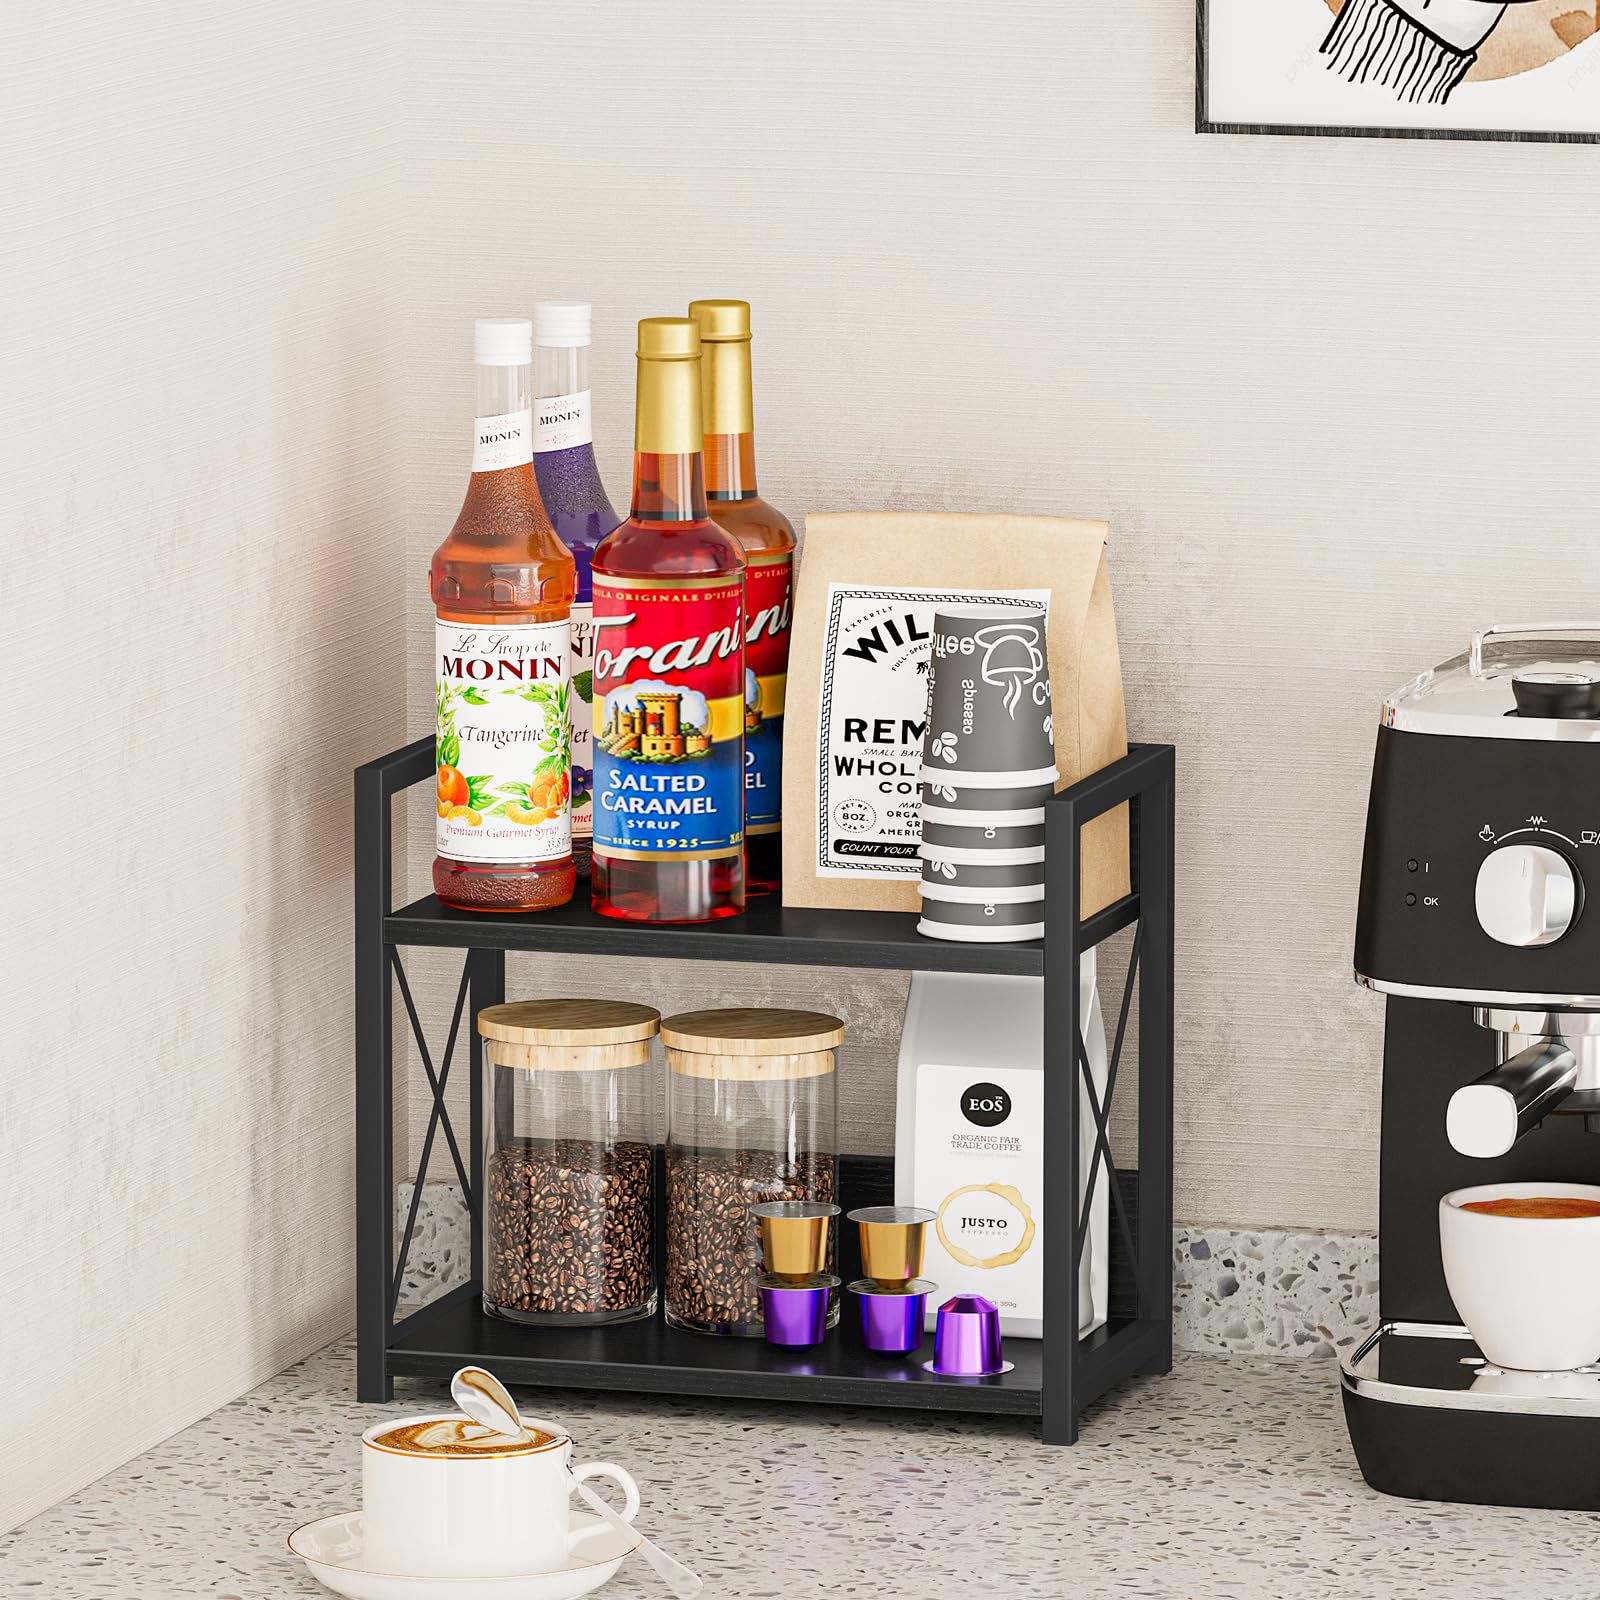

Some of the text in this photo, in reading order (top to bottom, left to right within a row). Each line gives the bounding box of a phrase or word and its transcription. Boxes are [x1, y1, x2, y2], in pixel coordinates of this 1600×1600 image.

[540, 409, 580, 426] MONIN
[480, 428, 521, 445] MONIN
[616, 591, 699, 602] ORIGINALE
[844, 606, 893, 633] EXPERTLY
[452, 633, 552, 659] Le Sirop de
[442, 655, 561, 680] MONIN
[458, 724, 544, 750] Tangerine
[862, 748, 895, 756] SMALL
[834, 755, 922, 776] WHOL
[609, 769, 706, 793] SALTED
[601, 790, 717, 815] CARAMEL
[445, 824, 483, 836] Premium
[486, 826, 533, 838] Gourmet
[627, 819, 681, 830] SYRUP
[612, 836, 700, 849] SINCE 1925
[840, 843, 914, 855] COUNT YOUR
[1423, 896, 1439, 906] OK
[968, 1098, 1004, 1112] EOS
[952, 1134, 1020, 1144] ORGANIC FAIR
[950, 1141, 1022, 1152] TRADE COFFEE
[961, 1217, 1008, 1229] JUSTO
